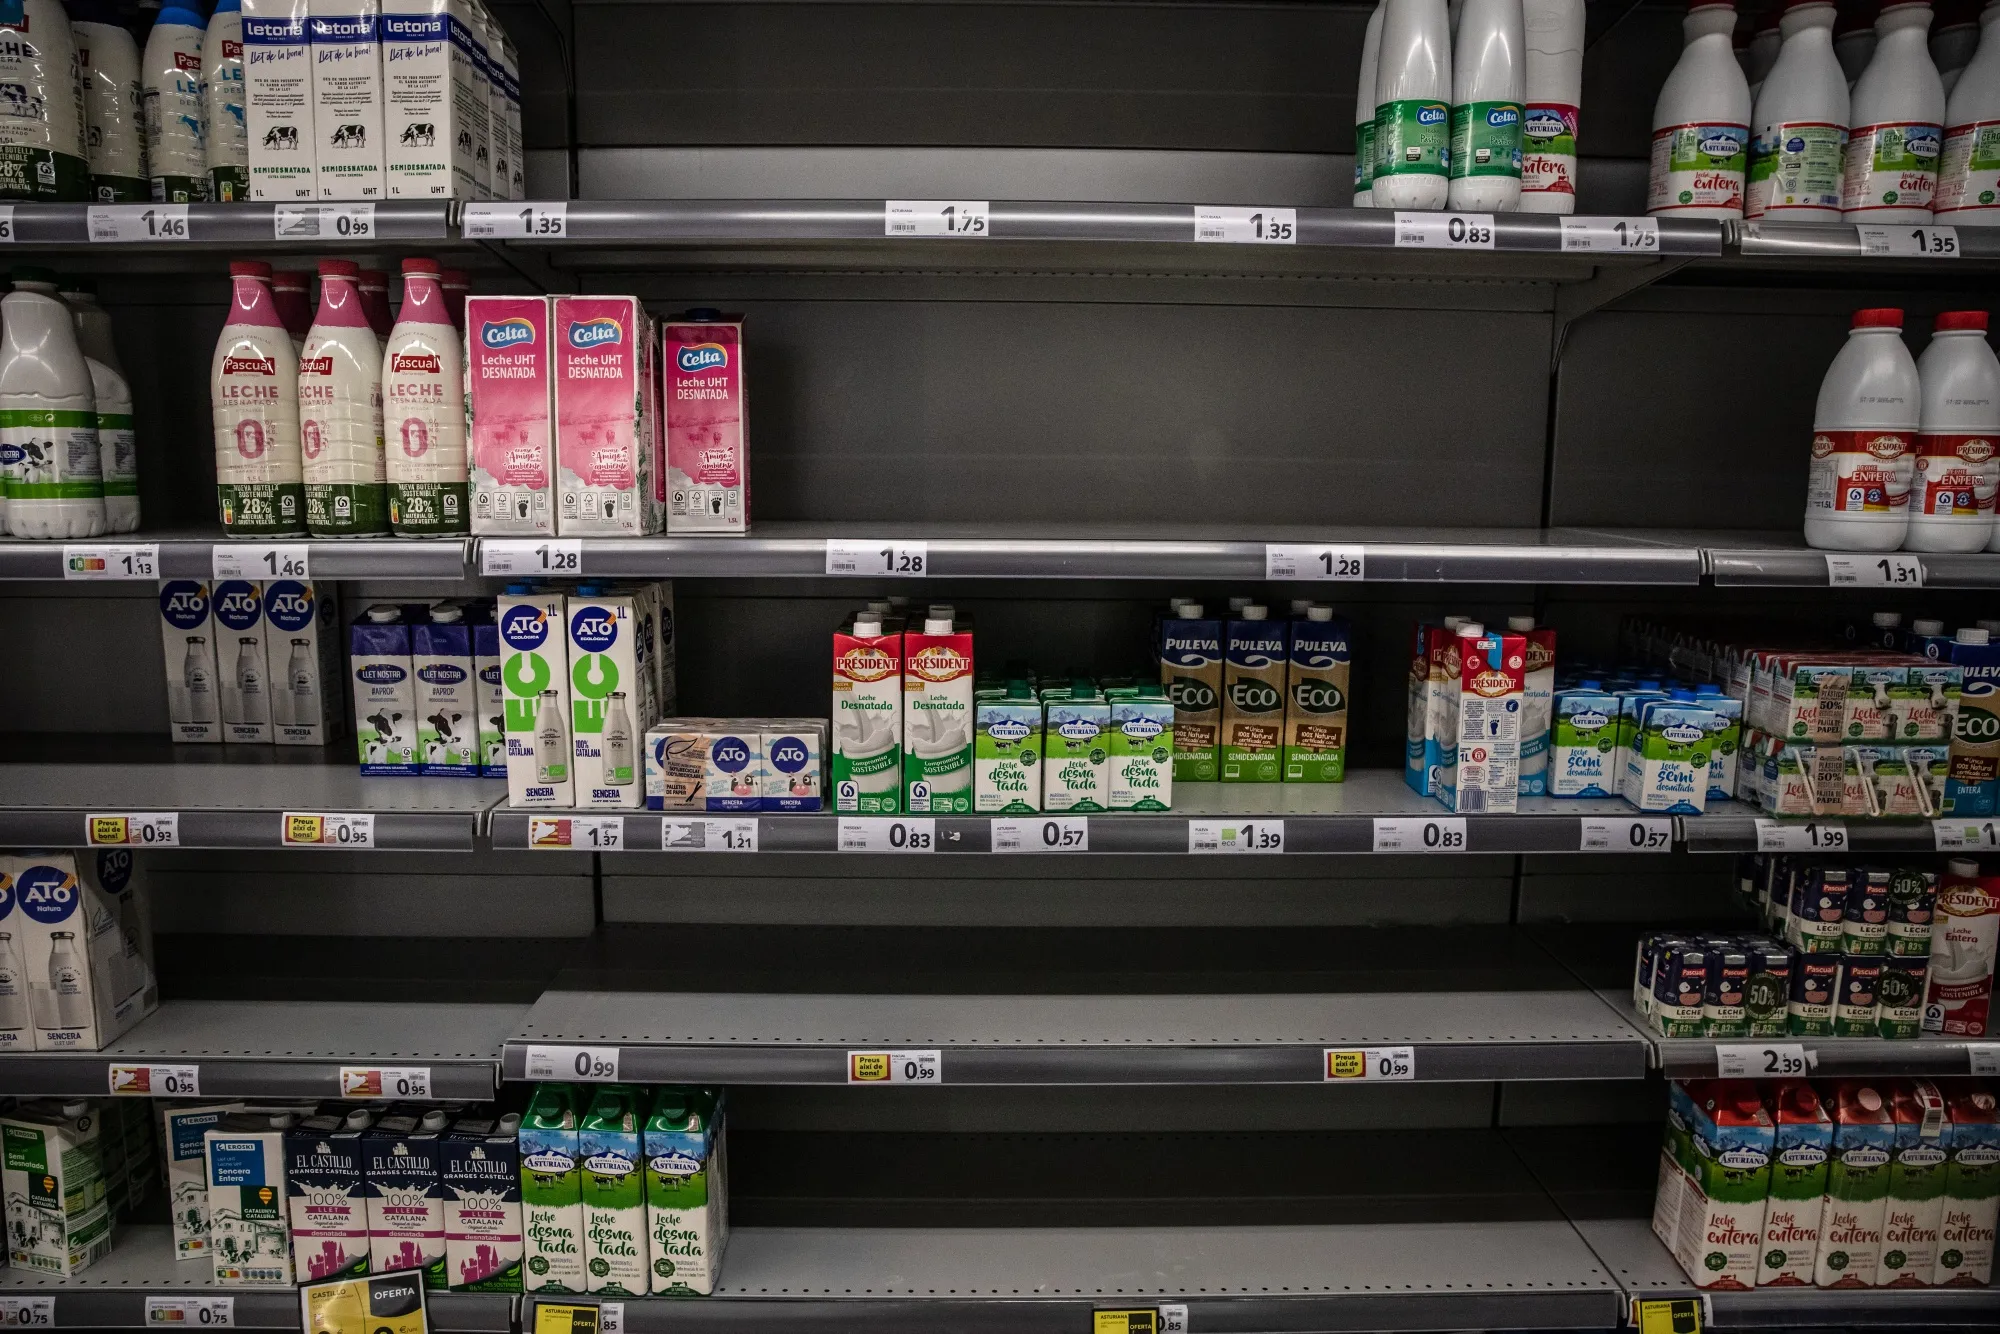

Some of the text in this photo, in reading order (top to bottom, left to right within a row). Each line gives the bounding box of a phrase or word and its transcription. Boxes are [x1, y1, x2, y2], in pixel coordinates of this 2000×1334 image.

[248, 22, 303, 37] letona
[316, 20, 370, 35] letona
[387, 19, 441, 33] letona
[1420, 112, 1444, 122] Celta
[1490, 112, 1517, 123] Celta
[1694, 174, 1739, 191] entera
[141, 210, 184, 237] 1,46
[336, 216, 368, 236] 0,99
[519, 208, 562, 234] 1,35
[940, 206, 985, 233] 1,75
[1249, 213, 1292, 240] 1,35
[1448, 218, 1491, 243] 0,83
[1613, 221, 1655, 247] 1,75
[1912, 230, 1955, 253] 1,35
[487, 326, 528, 343] Celta
[574, 326, 615, 343] Celta
[226, 359, 272, 371] Pascual
[482, 355, 535, 365] Leche UHT
[569, 355, 622, 365] Leche UHT
[682, 350, 721, 365] Celta
[482, 367, 536, 379] DESNATADA
[569, 367, 622, 379] DESNATADA
[390, 383, 443, 396] LECHE
[677, 377, 705, 387] Leche
[222, 385, 279, 398] LECHE
[678, 389, 728, 400] DESNATADA
[1852, 471, 1897, 482] ENTERA
[243, 499, 272, 513] 28%
[263, 551, 305, 576] 1,46
[534, 544, 577, 570] 1,28
[879, 546, 923, 573] 1,28
[1319, 551, 1360, 576] 1,28
[121, 555, 152, 576] 1,13
[1877, 559, 1916, 583] 1,31
[166, 592, 204, 611] ATO
[271, 594, 309, 613] ATO
[507, 616, 543, 634] ATO
[576, 618, 612, 636] ATO
[1165, 638, 1219, 650] PULEVA
[1229, 638, 1283, 651] PULEVA
[837, 656, 898, 669] PRÉSIDENT
[438, 671, 461, 679] NOSTRA
[1471, 678, 1516, 689] PRÉSIDENT
[1168, 684, 1213, 706] Eco
[1232, 684, 1277, 706] Eco
[1296, 685, 1341, 706] Eco
[841, 700, 893, 710] Desnatada
[913, 700, 965, 710] Desnatada
[1819, 701, 1842, 710] 50%
[233, 726, 260, 734] SENCERA
[990, 727, 1028, 736] ASTURIANA
[1061, 727, 1097, 735] ASTURIANA
[1123, 725, 1160, 734] ASTURIANA
[1664, 730, 1701, 738] ASTURIANA
[509, 747, 534, 756] CATALANA
[576, 748, 601, 757] CATALANA
[717, 747, 745, 762] ATO
[775, 748, 804, 762] ATO
[1068, 761, 1088, 770] Leche
[1818, 772, 1841, 781] 50%
[526, 788, 554, 797] SENCERA
[592, 789, 620, 798] SENCERA
[1957, 786, 1981, 794] ENTERA
[143, 824, 172, 843] 0,93
[337, 824, 367, 843] 0,95
[587, 828, 617, 846] 1,37
[721, 830, 752, 849] 1,21
[889, 823, 931, 849] 0,83
[1042, 822, 1084, 847] 0,57
[1240, 824, 1281, 849] 1,39
[1423, 822, 1463, 848] 0,83
[1629, 823, 1668, 848] 0,57
[1804, 823, 1844, 847] 1,99
[25, 882, 71, 903] ATO
[1937, 894, 1999, 908] PRÉSIDENT
[1945, 933, 1978, 943] Entera
[47, 1032, 81, 1040] SENCERA
[574, 1051, 615, 1077] 0,99
[859, 1056, 880, 1064] Preus
[1380, 1058, 1408, 1076] 0,99
[1762, 1050, 1802, 1073] 2,39
[904, 1057, 935, 1080] 0,99
[165, 1075, 194, 1093] 0,95
[397, 1078, 426, 1095] 0,95
[9, 1153, 25, 1161] Semi
[311, 1155, 352, 1168] CASTILLO
[527, 1158, 572, 1169] ASTURIANA
[1720, 1154, 1765, 1165] ASTURIANA
[1779, 1153, 1823, 1162] ASTURIANA
[530, 1211, 556, 1225] Leche
[590, 1213, 616, 1226] Leche
[1707, 1226, 1759, 1245] entera
[1768, 1223, 1817, 1242] entera
[312, 1289, 346, 1299] CASTILLO
[374, 1287, 415, 1300] OFERTA
[19, 1307, 48, 1324] 0,75
[199, 1307, 227, 1325] 0,75
